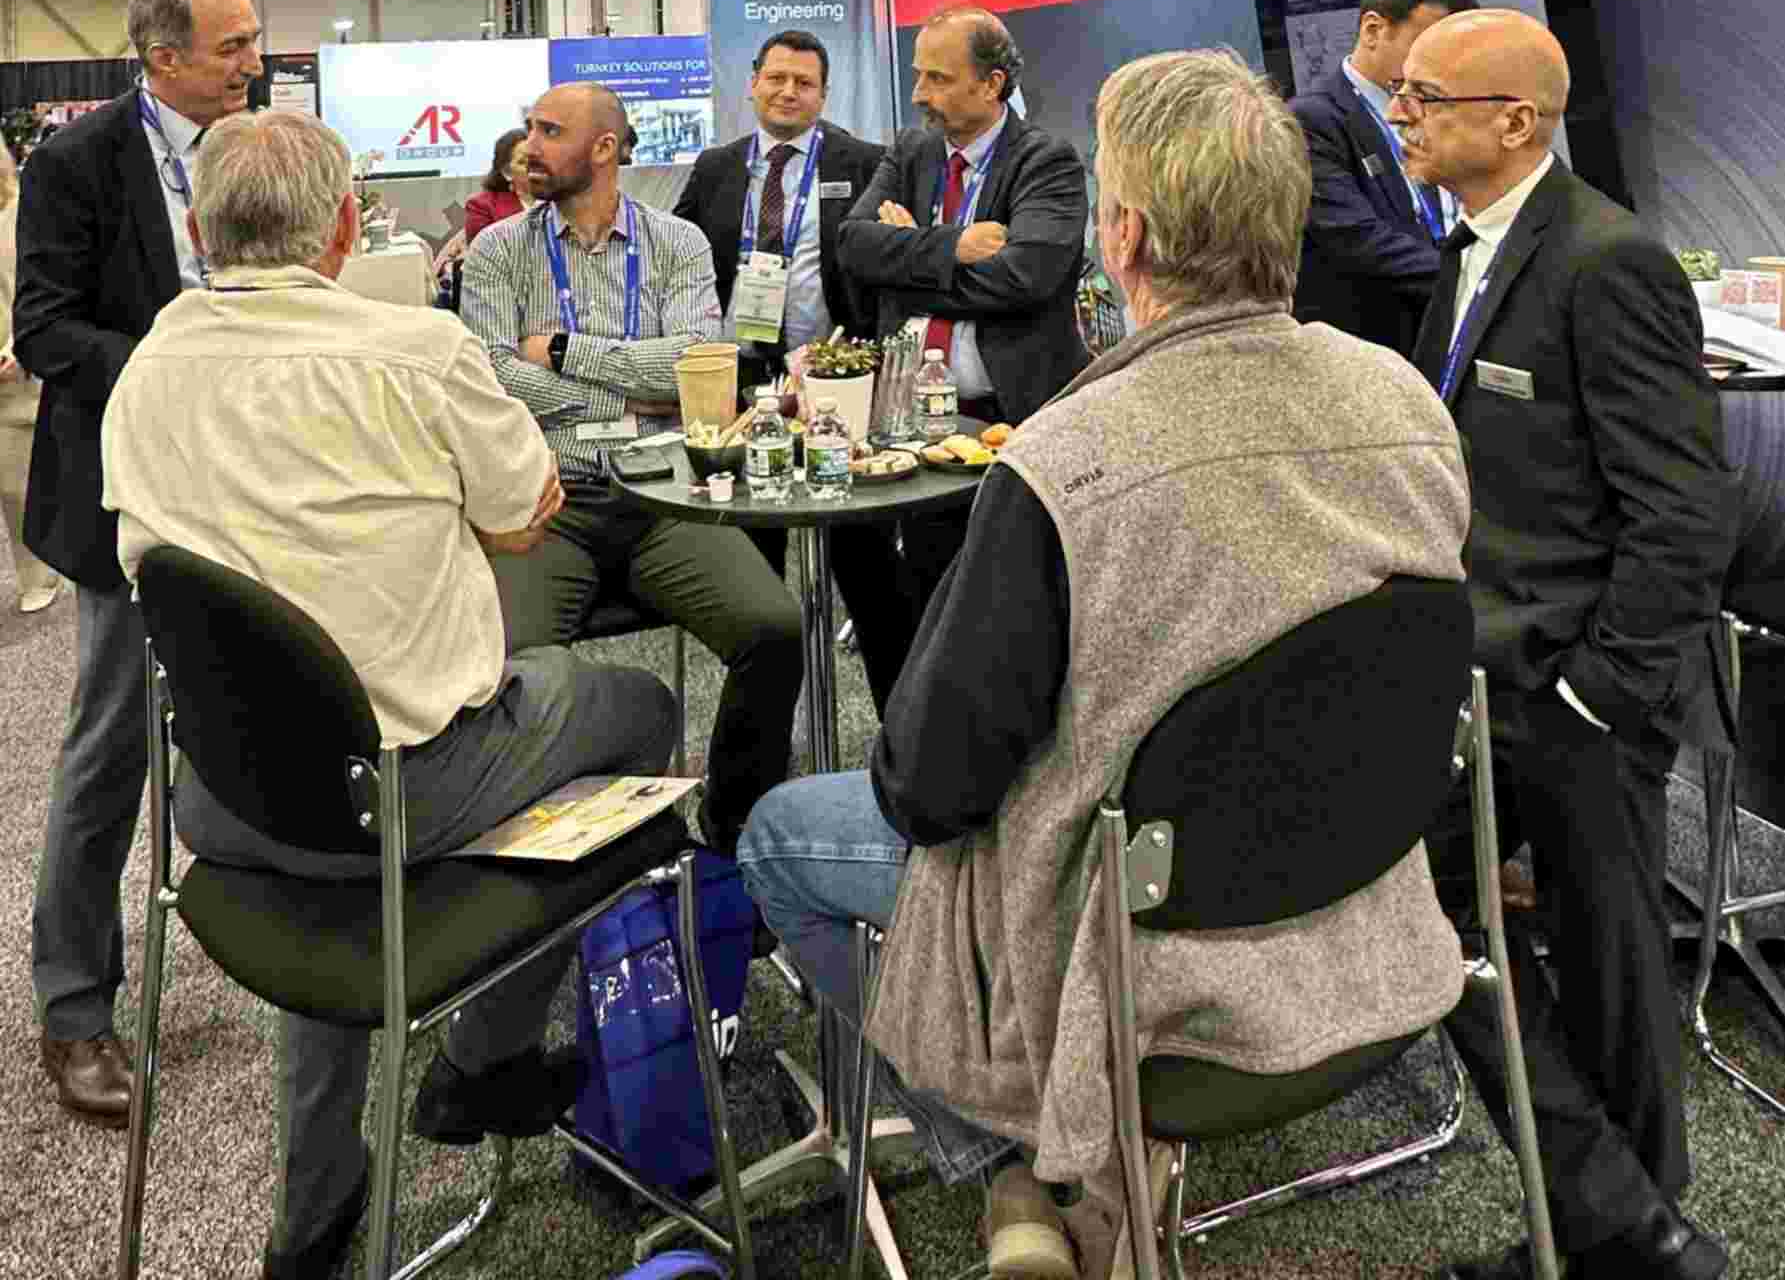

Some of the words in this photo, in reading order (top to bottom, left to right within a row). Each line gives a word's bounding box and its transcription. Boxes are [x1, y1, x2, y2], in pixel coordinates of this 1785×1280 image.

[744, 1, 845, 23] Engineering
[574, 63, 621, 74] TURNKEY
[623, 60, 682, 73] SOLUTIONS
[1063, 467, 1105, 494] ORVIS
